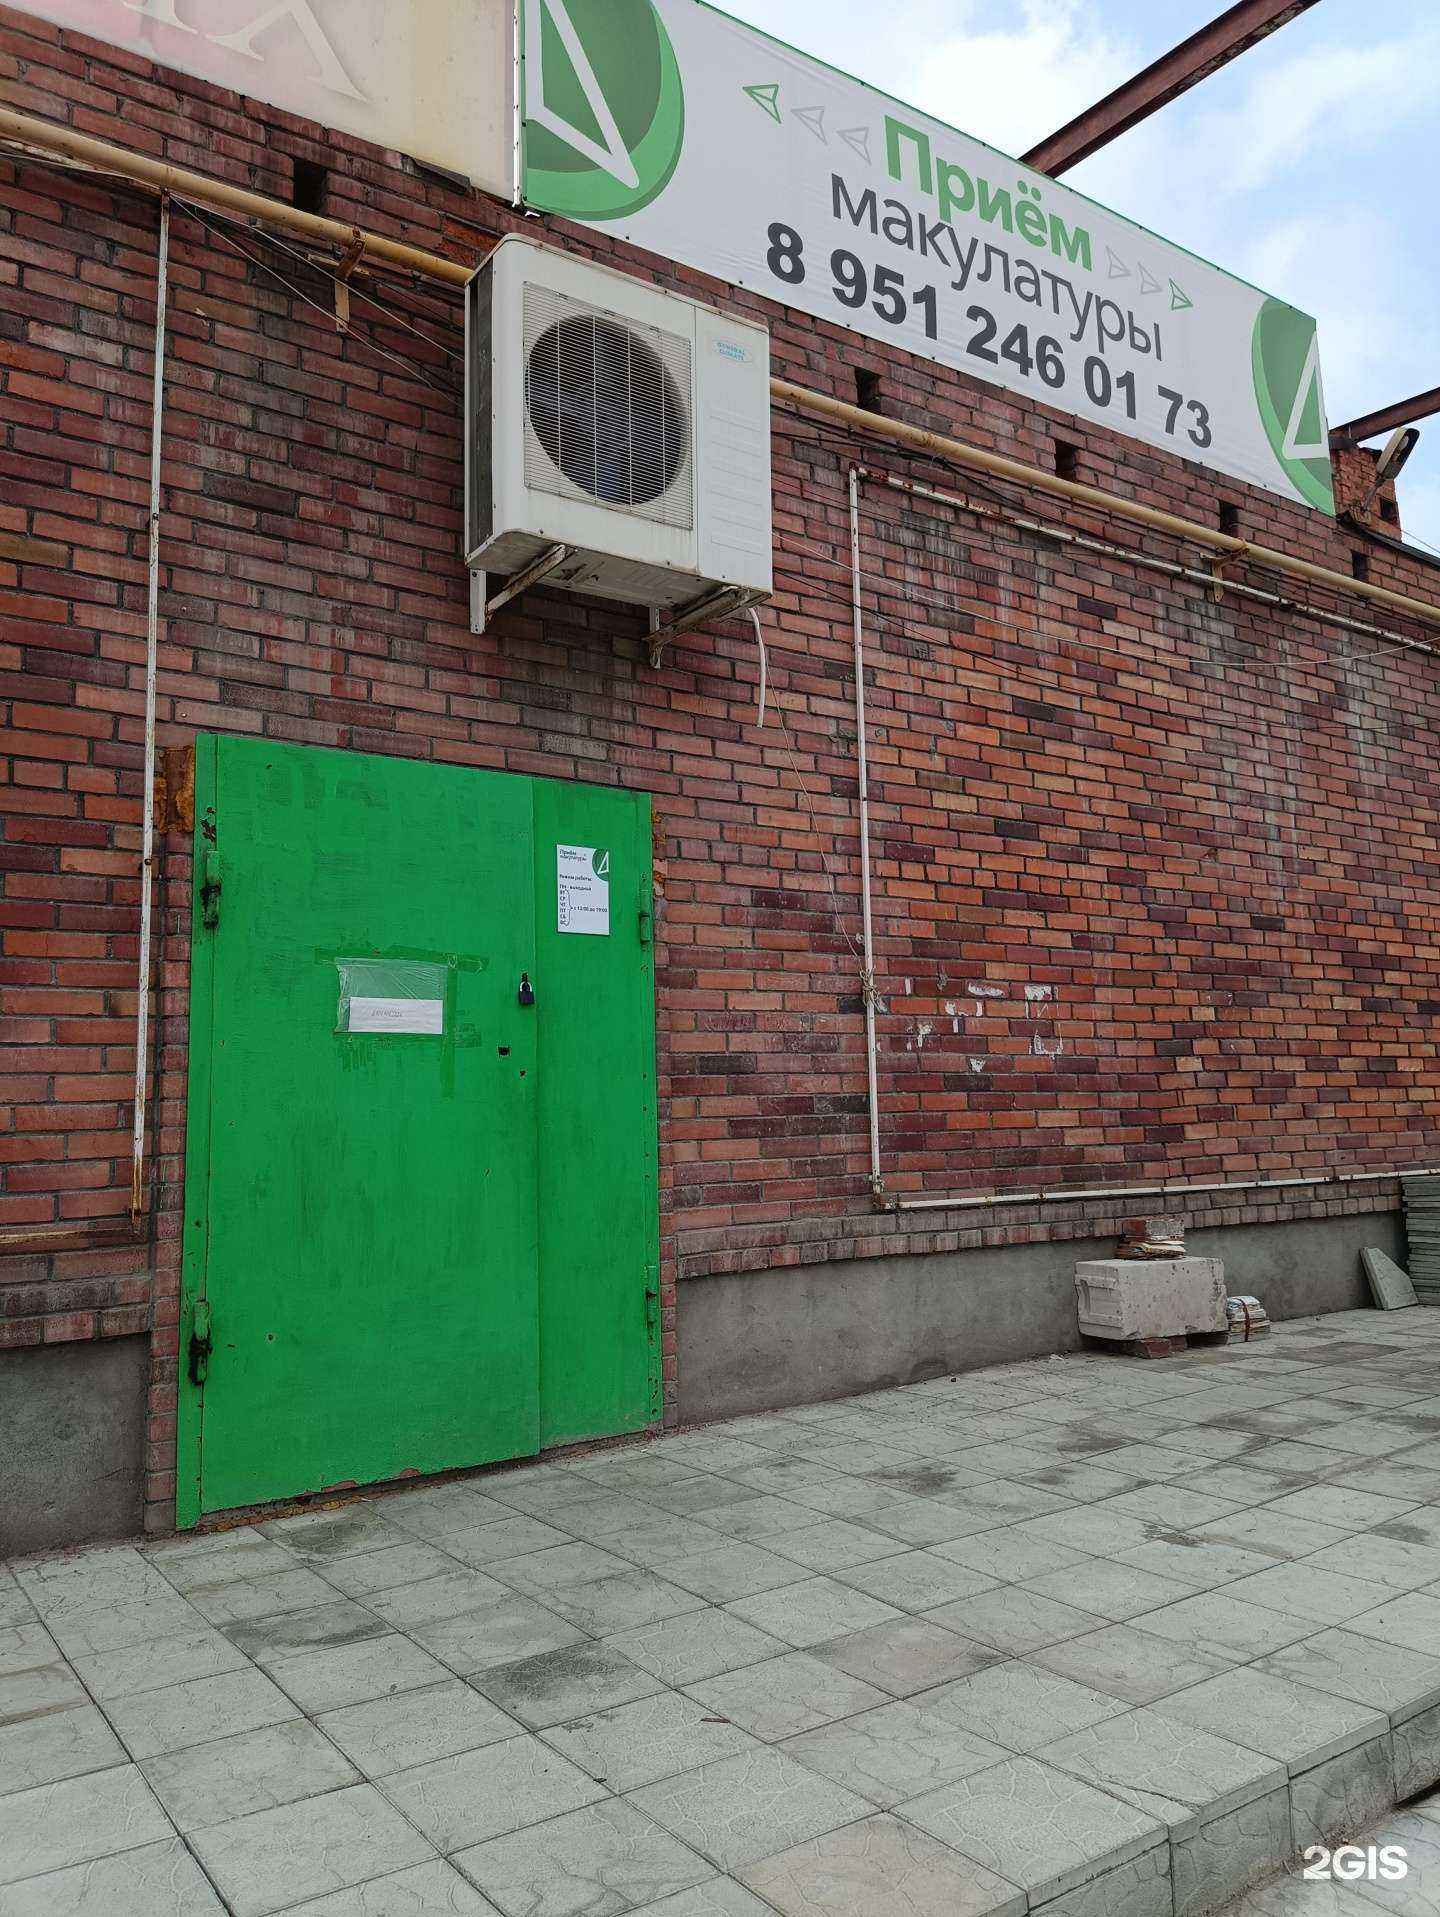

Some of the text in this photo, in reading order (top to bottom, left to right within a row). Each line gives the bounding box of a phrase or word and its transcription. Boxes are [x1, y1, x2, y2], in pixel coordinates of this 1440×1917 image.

[831, 172, 1163, 362] макулатуры
[884, 115, 1094, 272] Приём
[766, 221, 1212, 449] 8 951 246 01 73
